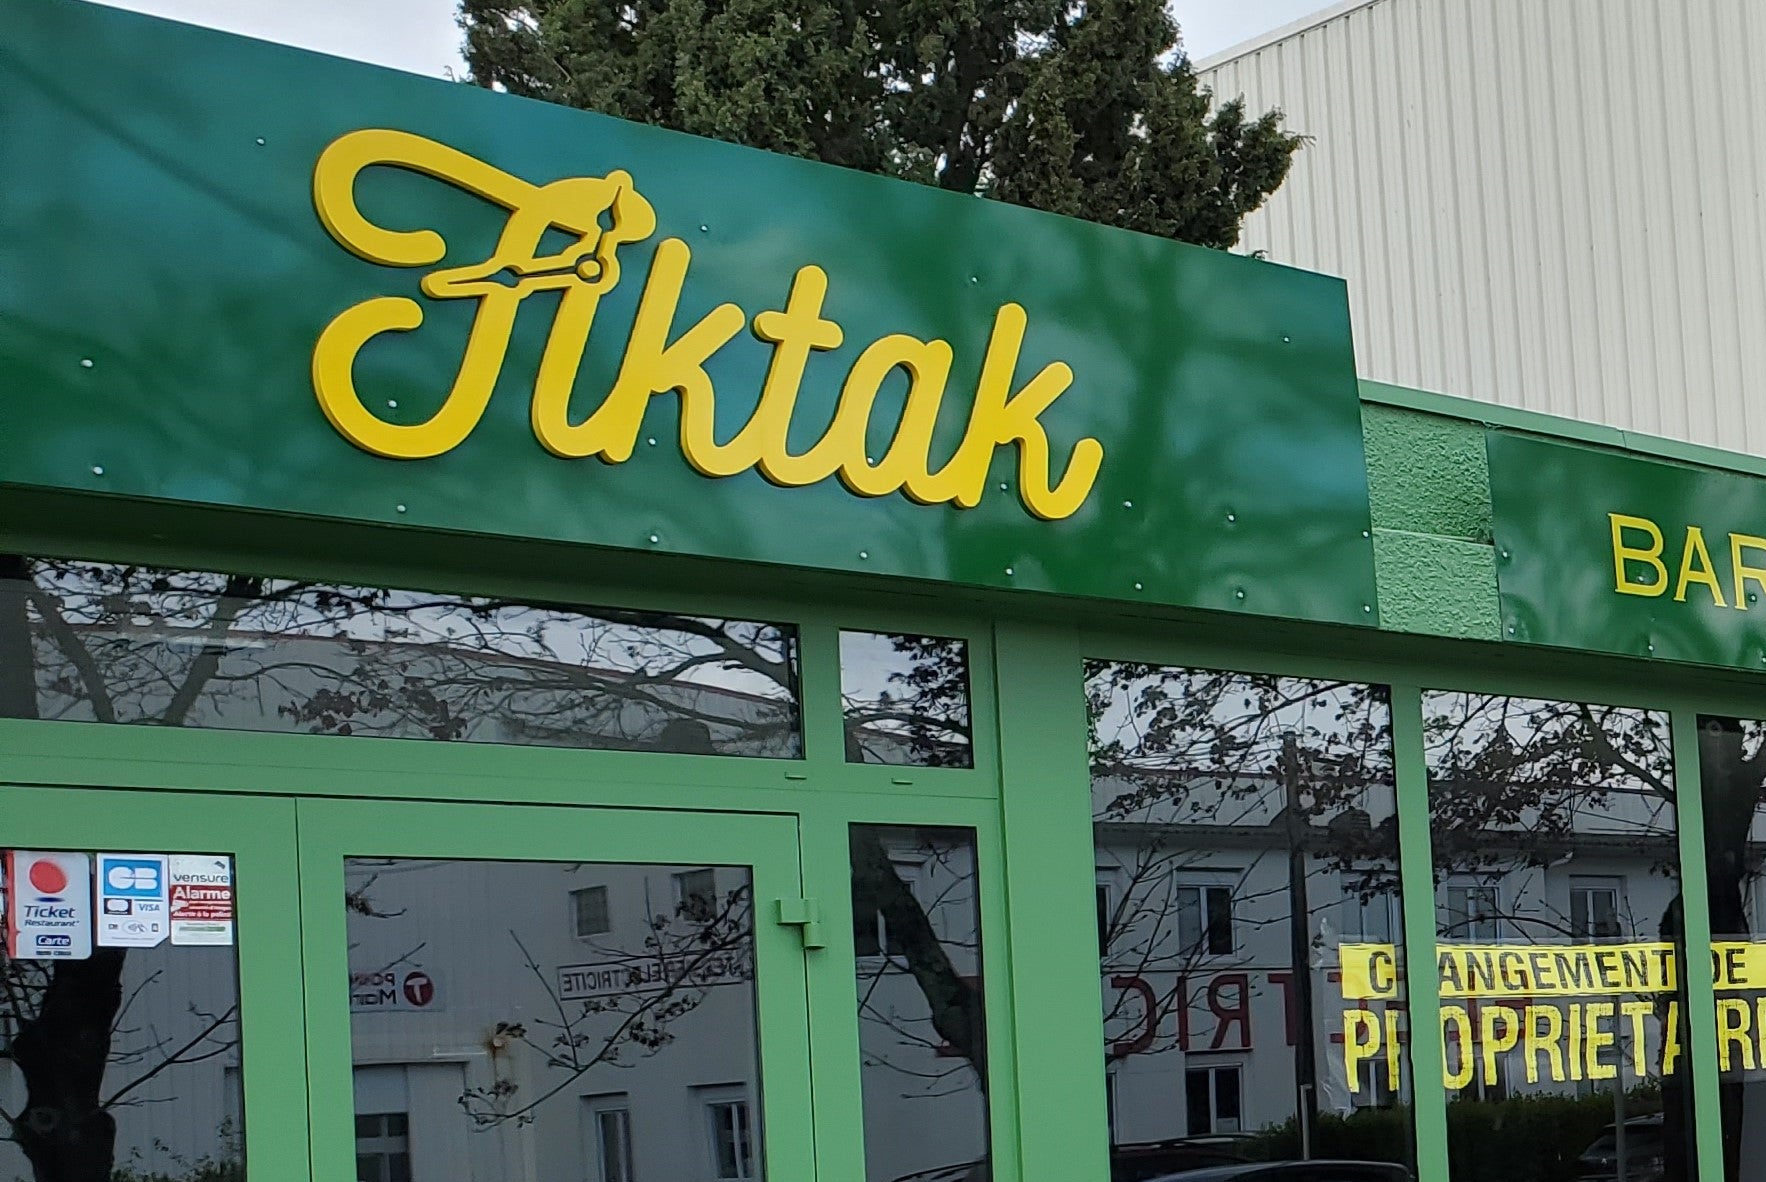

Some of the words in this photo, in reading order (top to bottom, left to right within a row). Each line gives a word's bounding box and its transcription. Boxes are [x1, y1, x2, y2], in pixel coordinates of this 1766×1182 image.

[173, 886, 232, 900] Alarme
[24, 905, 76, 919] Ticket
[138, 903, 160, 912] VISA
[37, 935, 70, 946] Carte
[1369, 948, 1674, 994] CANGEMENT
